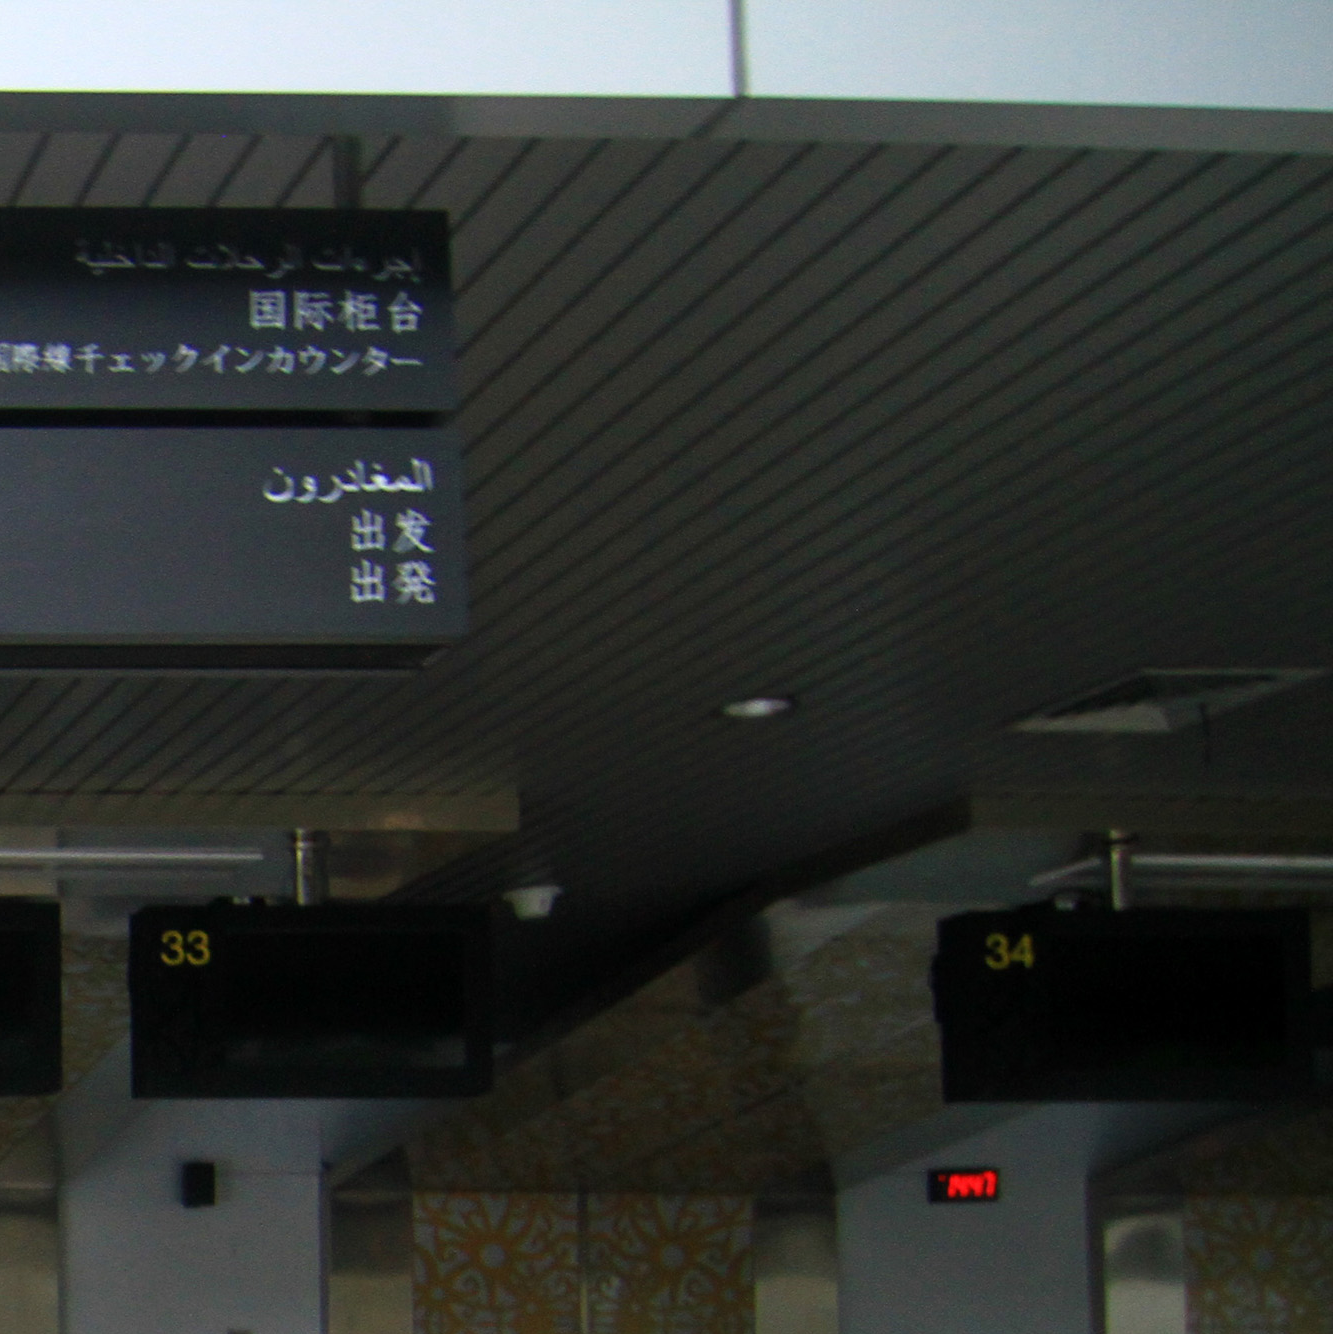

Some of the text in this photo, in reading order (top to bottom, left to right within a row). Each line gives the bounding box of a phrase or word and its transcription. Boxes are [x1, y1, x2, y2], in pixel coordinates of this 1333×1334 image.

[249, 289, 423, 334] 国际柜台
[350, 508, 436, 554] 出发
[350, 558, 437, 604] 出発
[160, 929, 212, 967] 33
[985, 933, 1034, 969] 34
